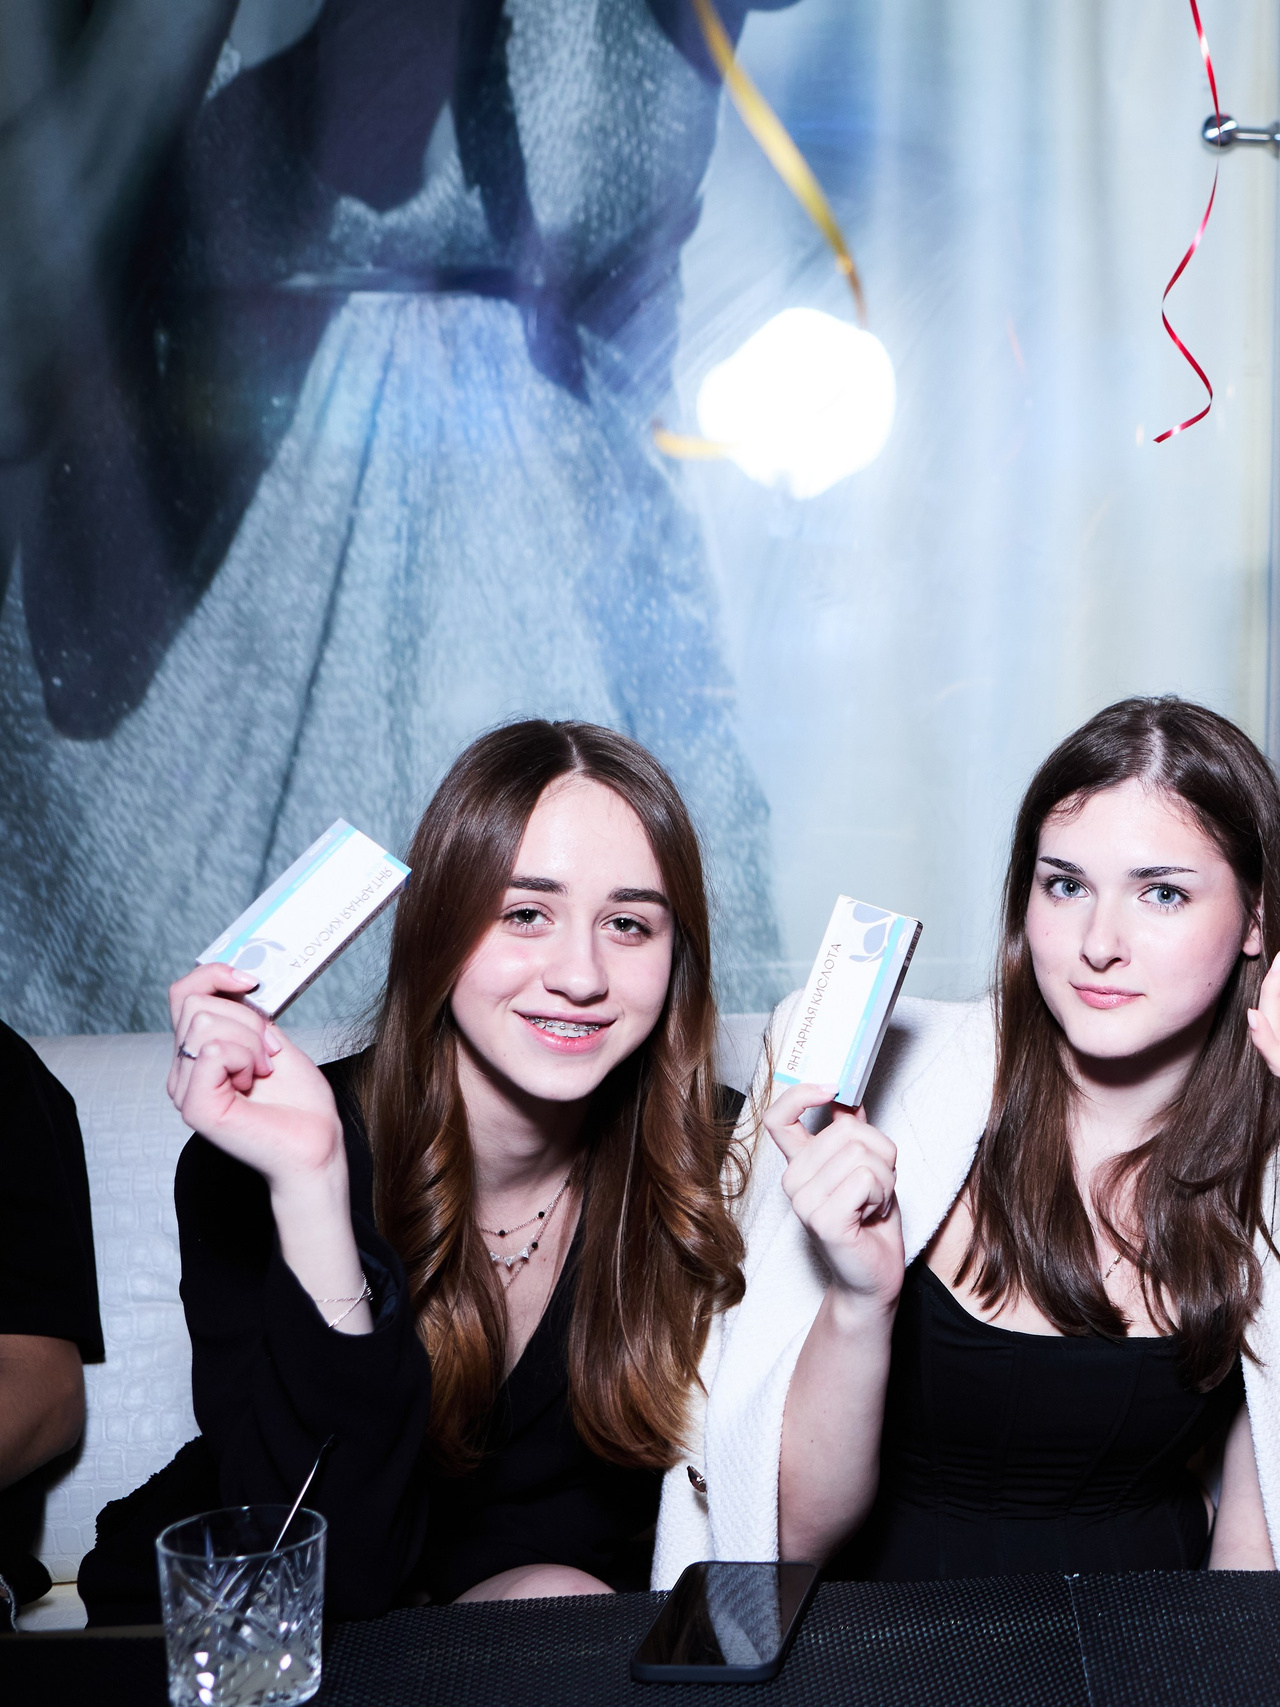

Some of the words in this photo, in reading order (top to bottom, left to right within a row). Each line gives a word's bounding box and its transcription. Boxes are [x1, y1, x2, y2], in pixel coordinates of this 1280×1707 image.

[343, 865, 393, 921] ЯНТАРНАЯ
[290, 917, 344, 968] КИСЛОТА
[787, 1006, 818, 1072] ЯНТАРНАЯ
[811, 943, 842, 1006] КИСЛОТА
